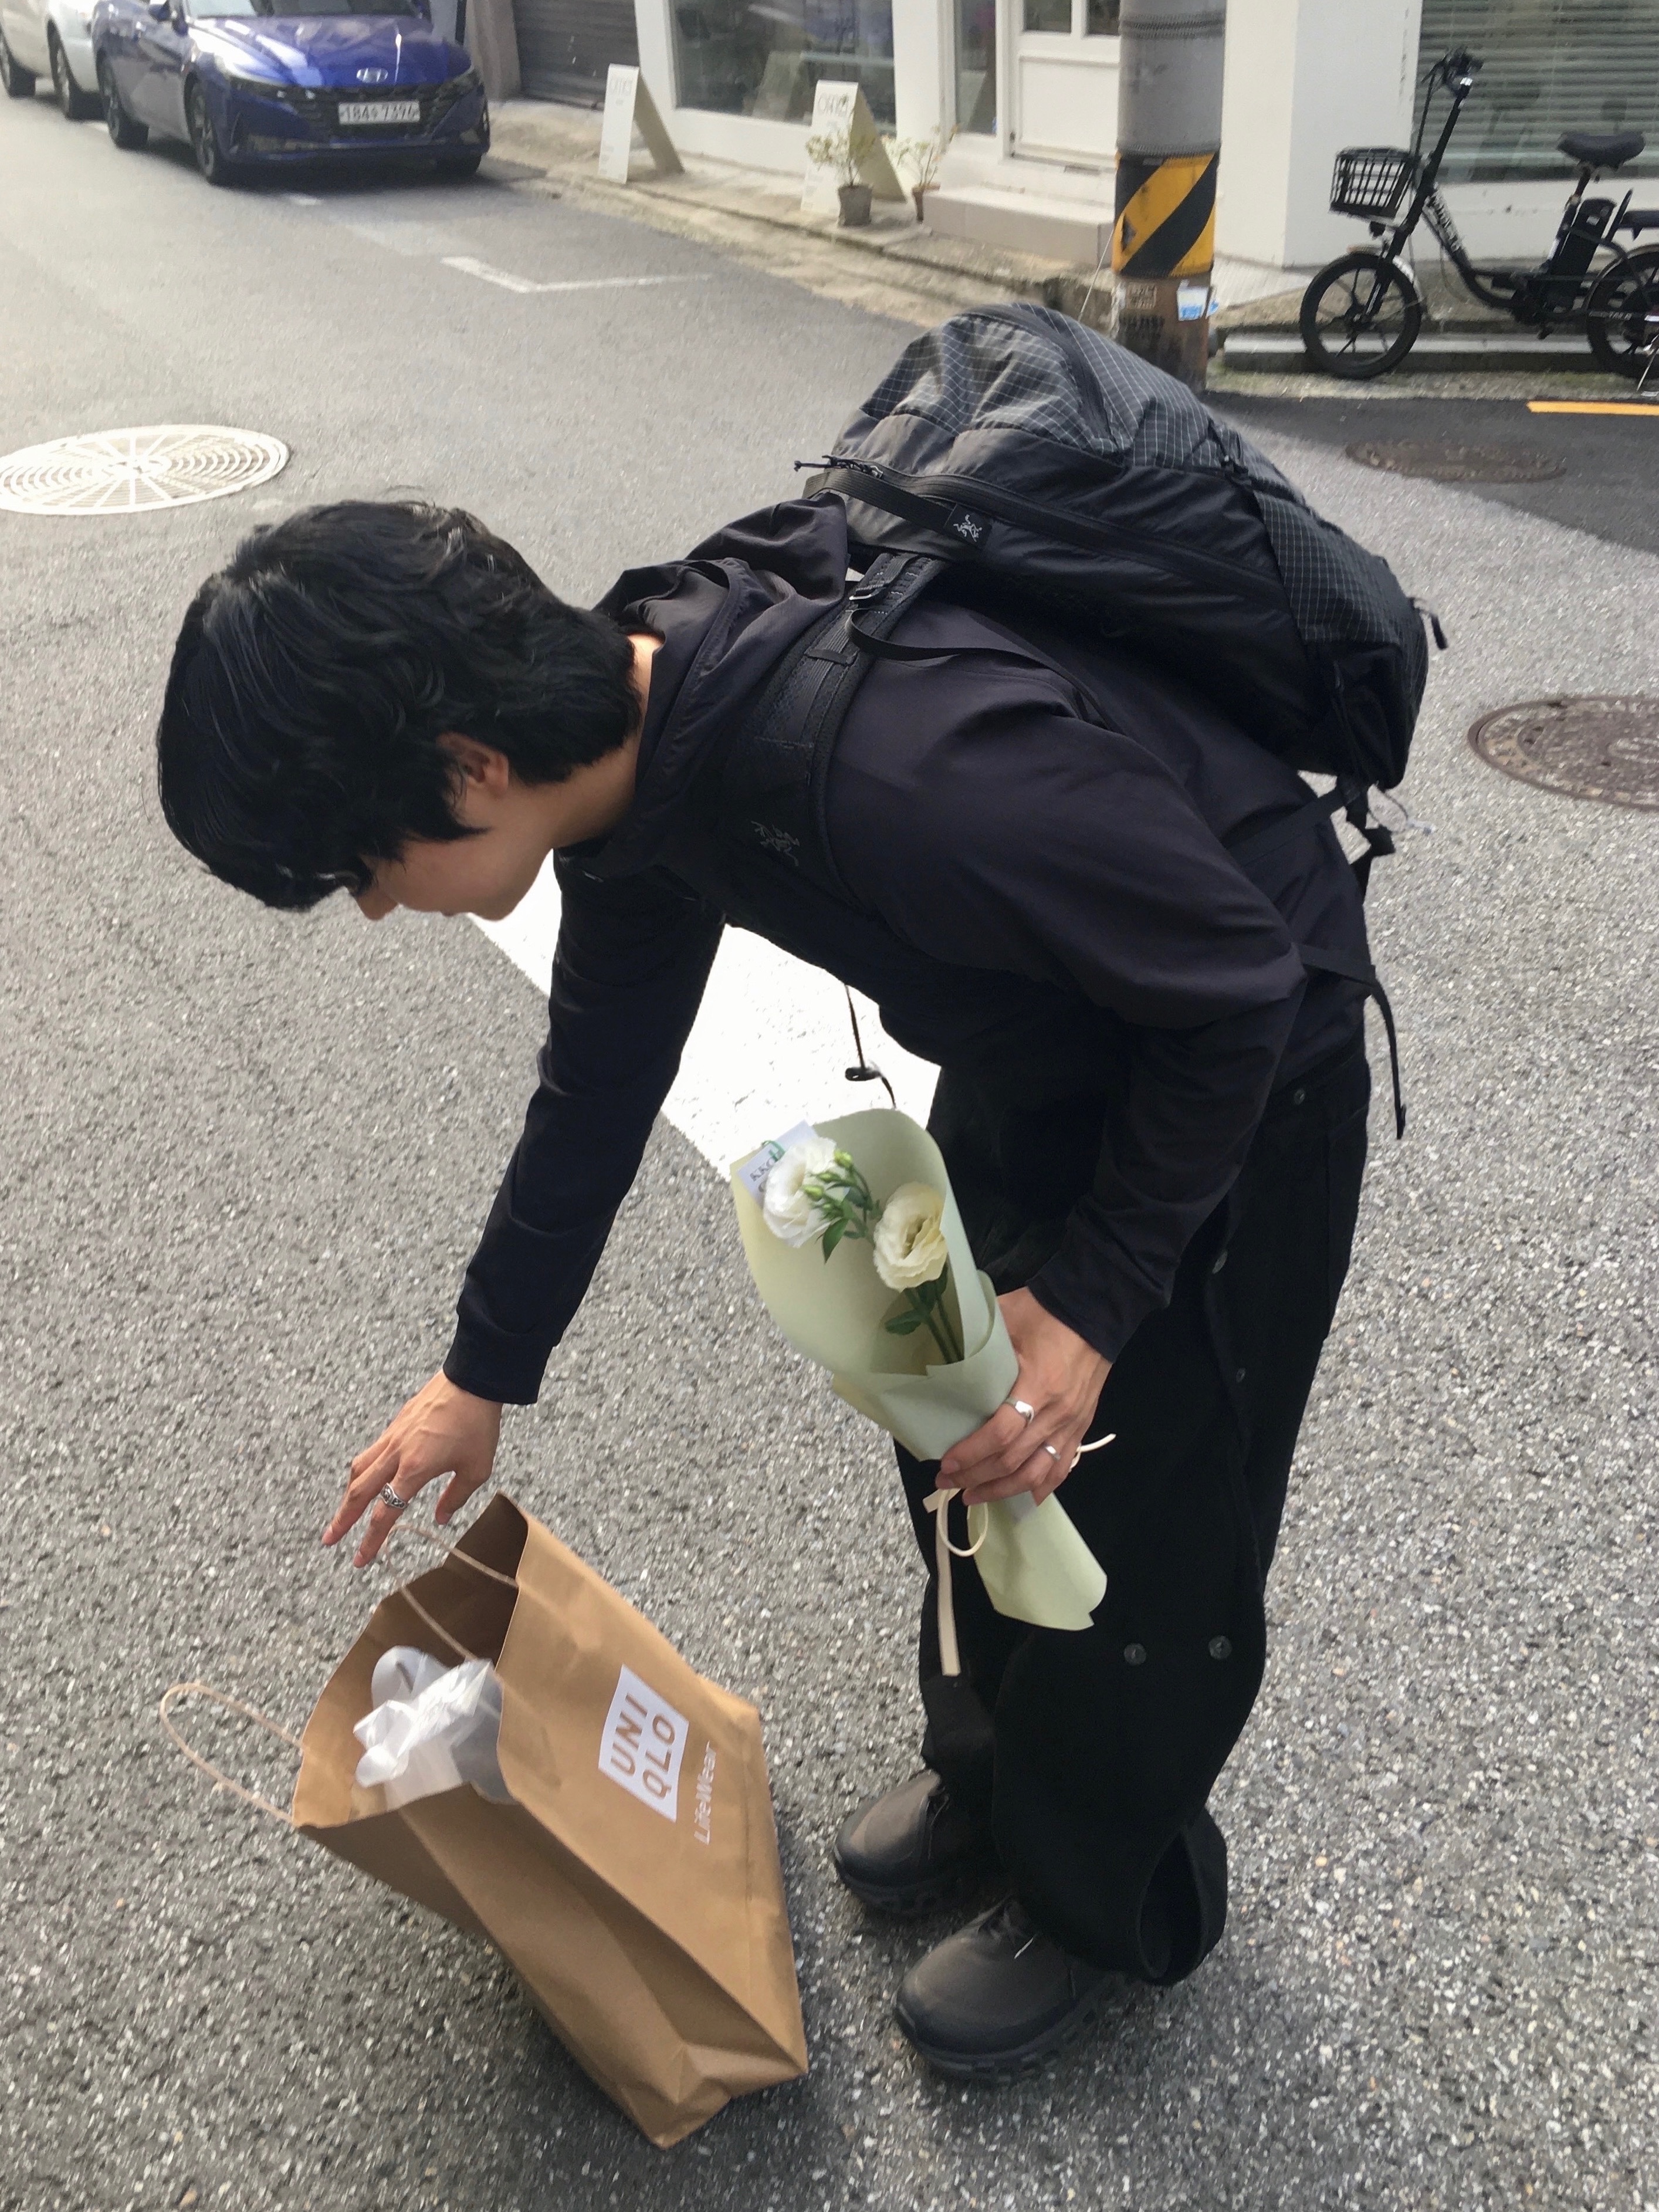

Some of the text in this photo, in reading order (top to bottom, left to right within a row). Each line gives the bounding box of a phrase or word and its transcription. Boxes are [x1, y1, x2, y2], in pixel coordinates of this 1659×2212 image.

[611, 1693, 648, 1777] UNI
[642, 1714, 676, 1800] QLO
[695, 1741, 717, 1845] LifeWear
